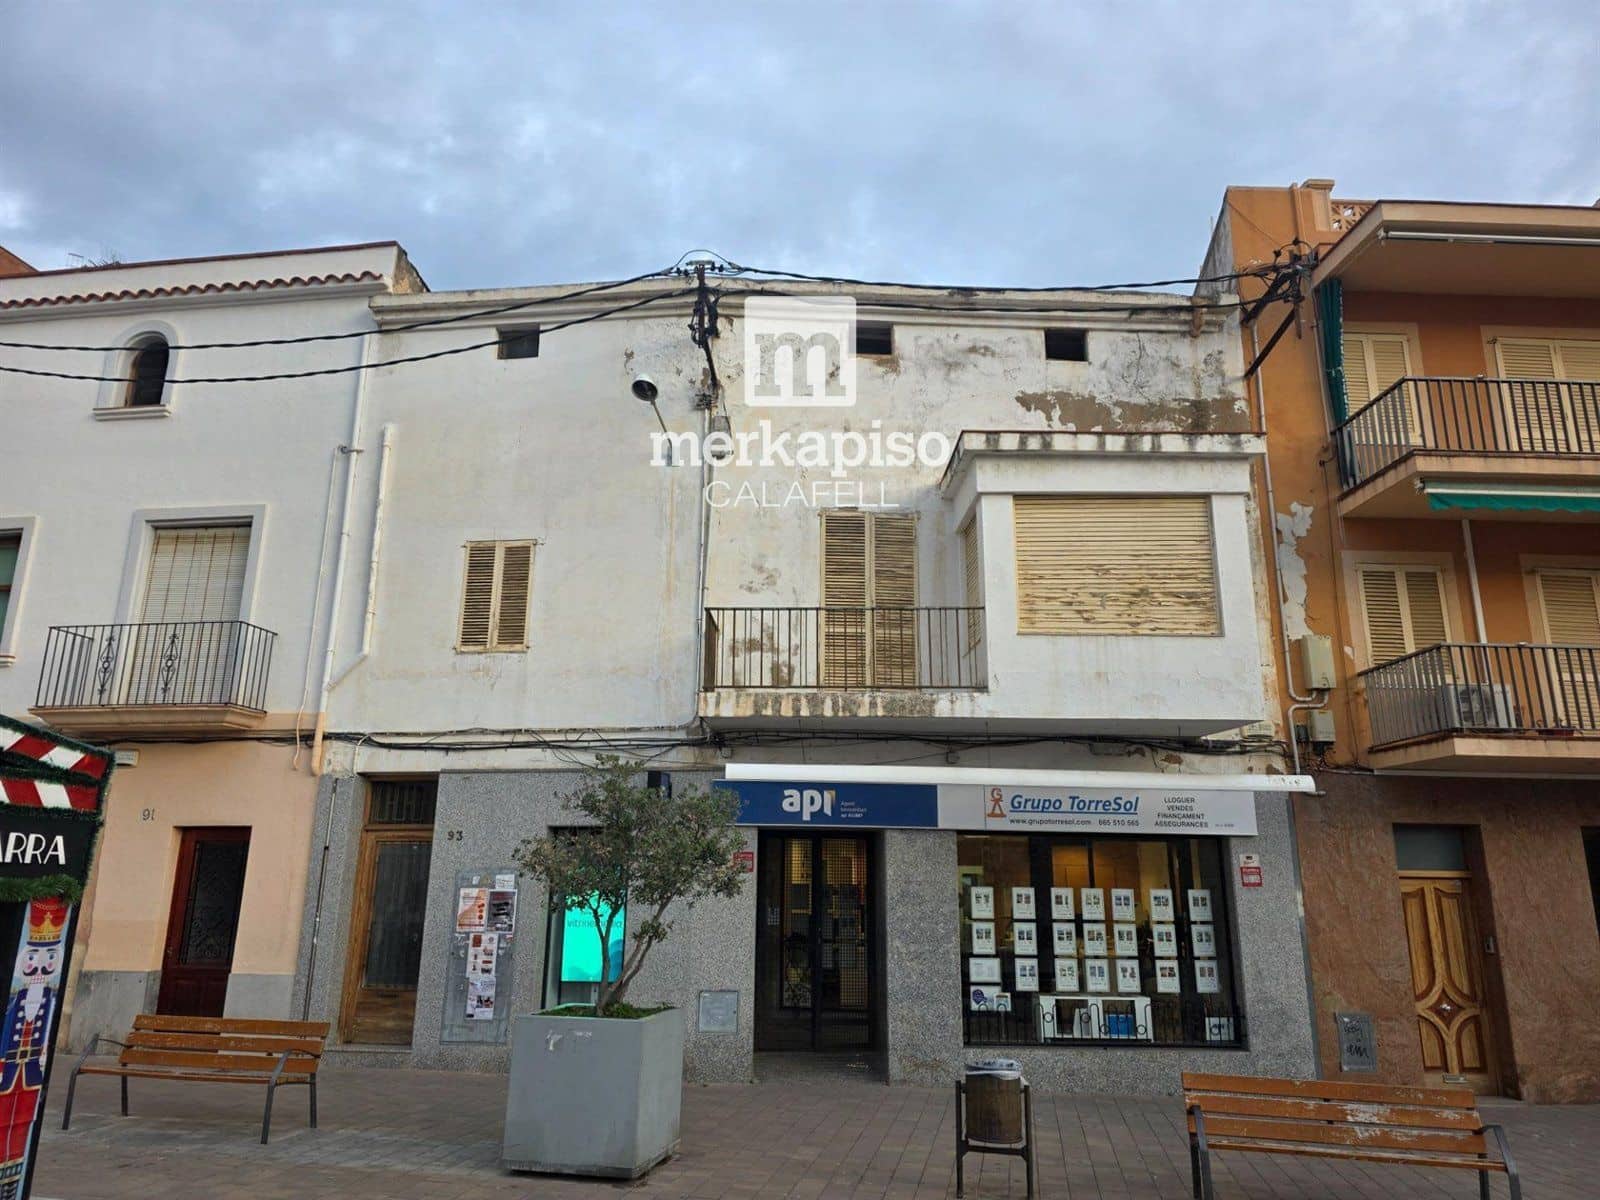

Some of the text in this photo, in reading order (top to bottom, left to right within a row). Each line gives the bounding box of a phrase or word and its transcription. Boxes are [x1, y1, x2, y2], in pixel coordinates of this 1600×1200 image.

[781, 788, 836, 821] api
[1010, 794, 1140, 813] Grupo TorreSol
[1154, 820, 1209, 829] ASSEGURANCES
[447, 831, 464, 842] 93
[0, 832, 66, 865] RRA
